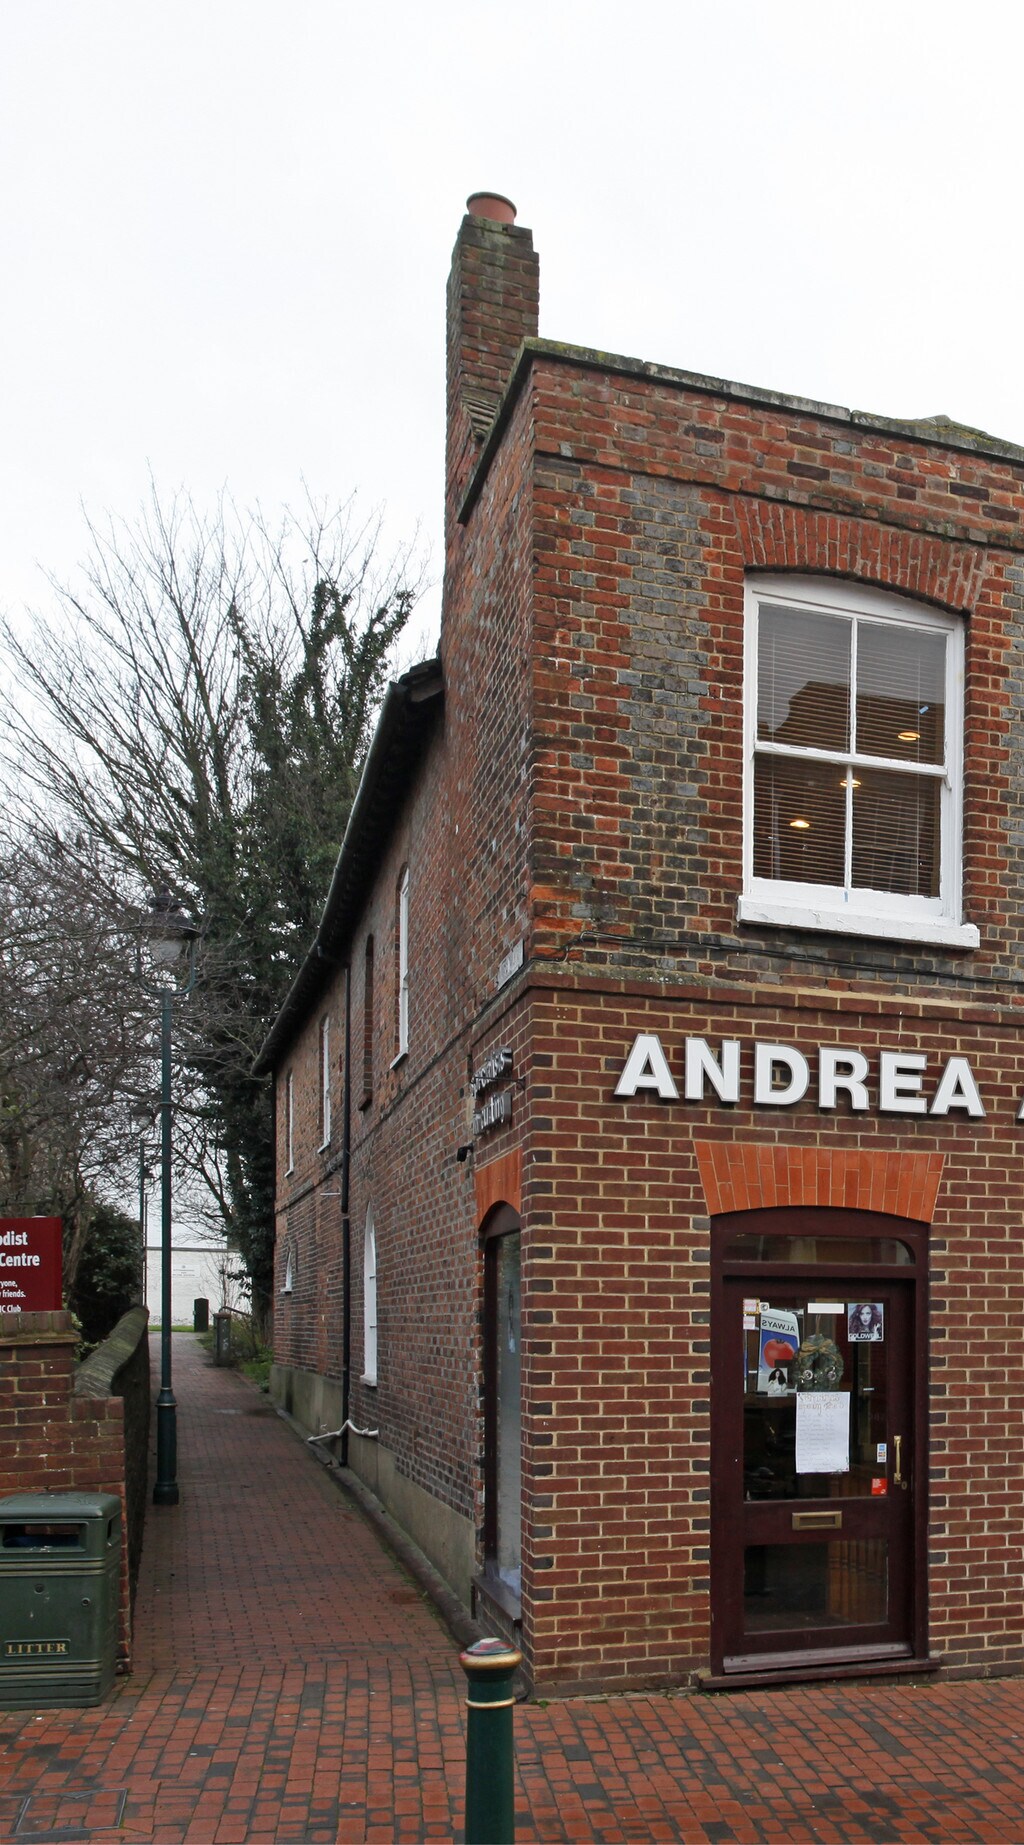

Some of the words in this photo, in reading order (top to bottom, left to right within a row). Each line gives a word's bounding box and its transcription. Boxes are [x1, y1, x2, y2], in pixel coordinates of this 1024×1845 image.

[614, 1033, 987, 1117] ANDREA
[0, 1231, 28, 1246] dist
[0, 1253, 40, 1267] Centre
[0, 1280, 18, 1289] yone,
[8, 1643, 66, 1654] LITTER
